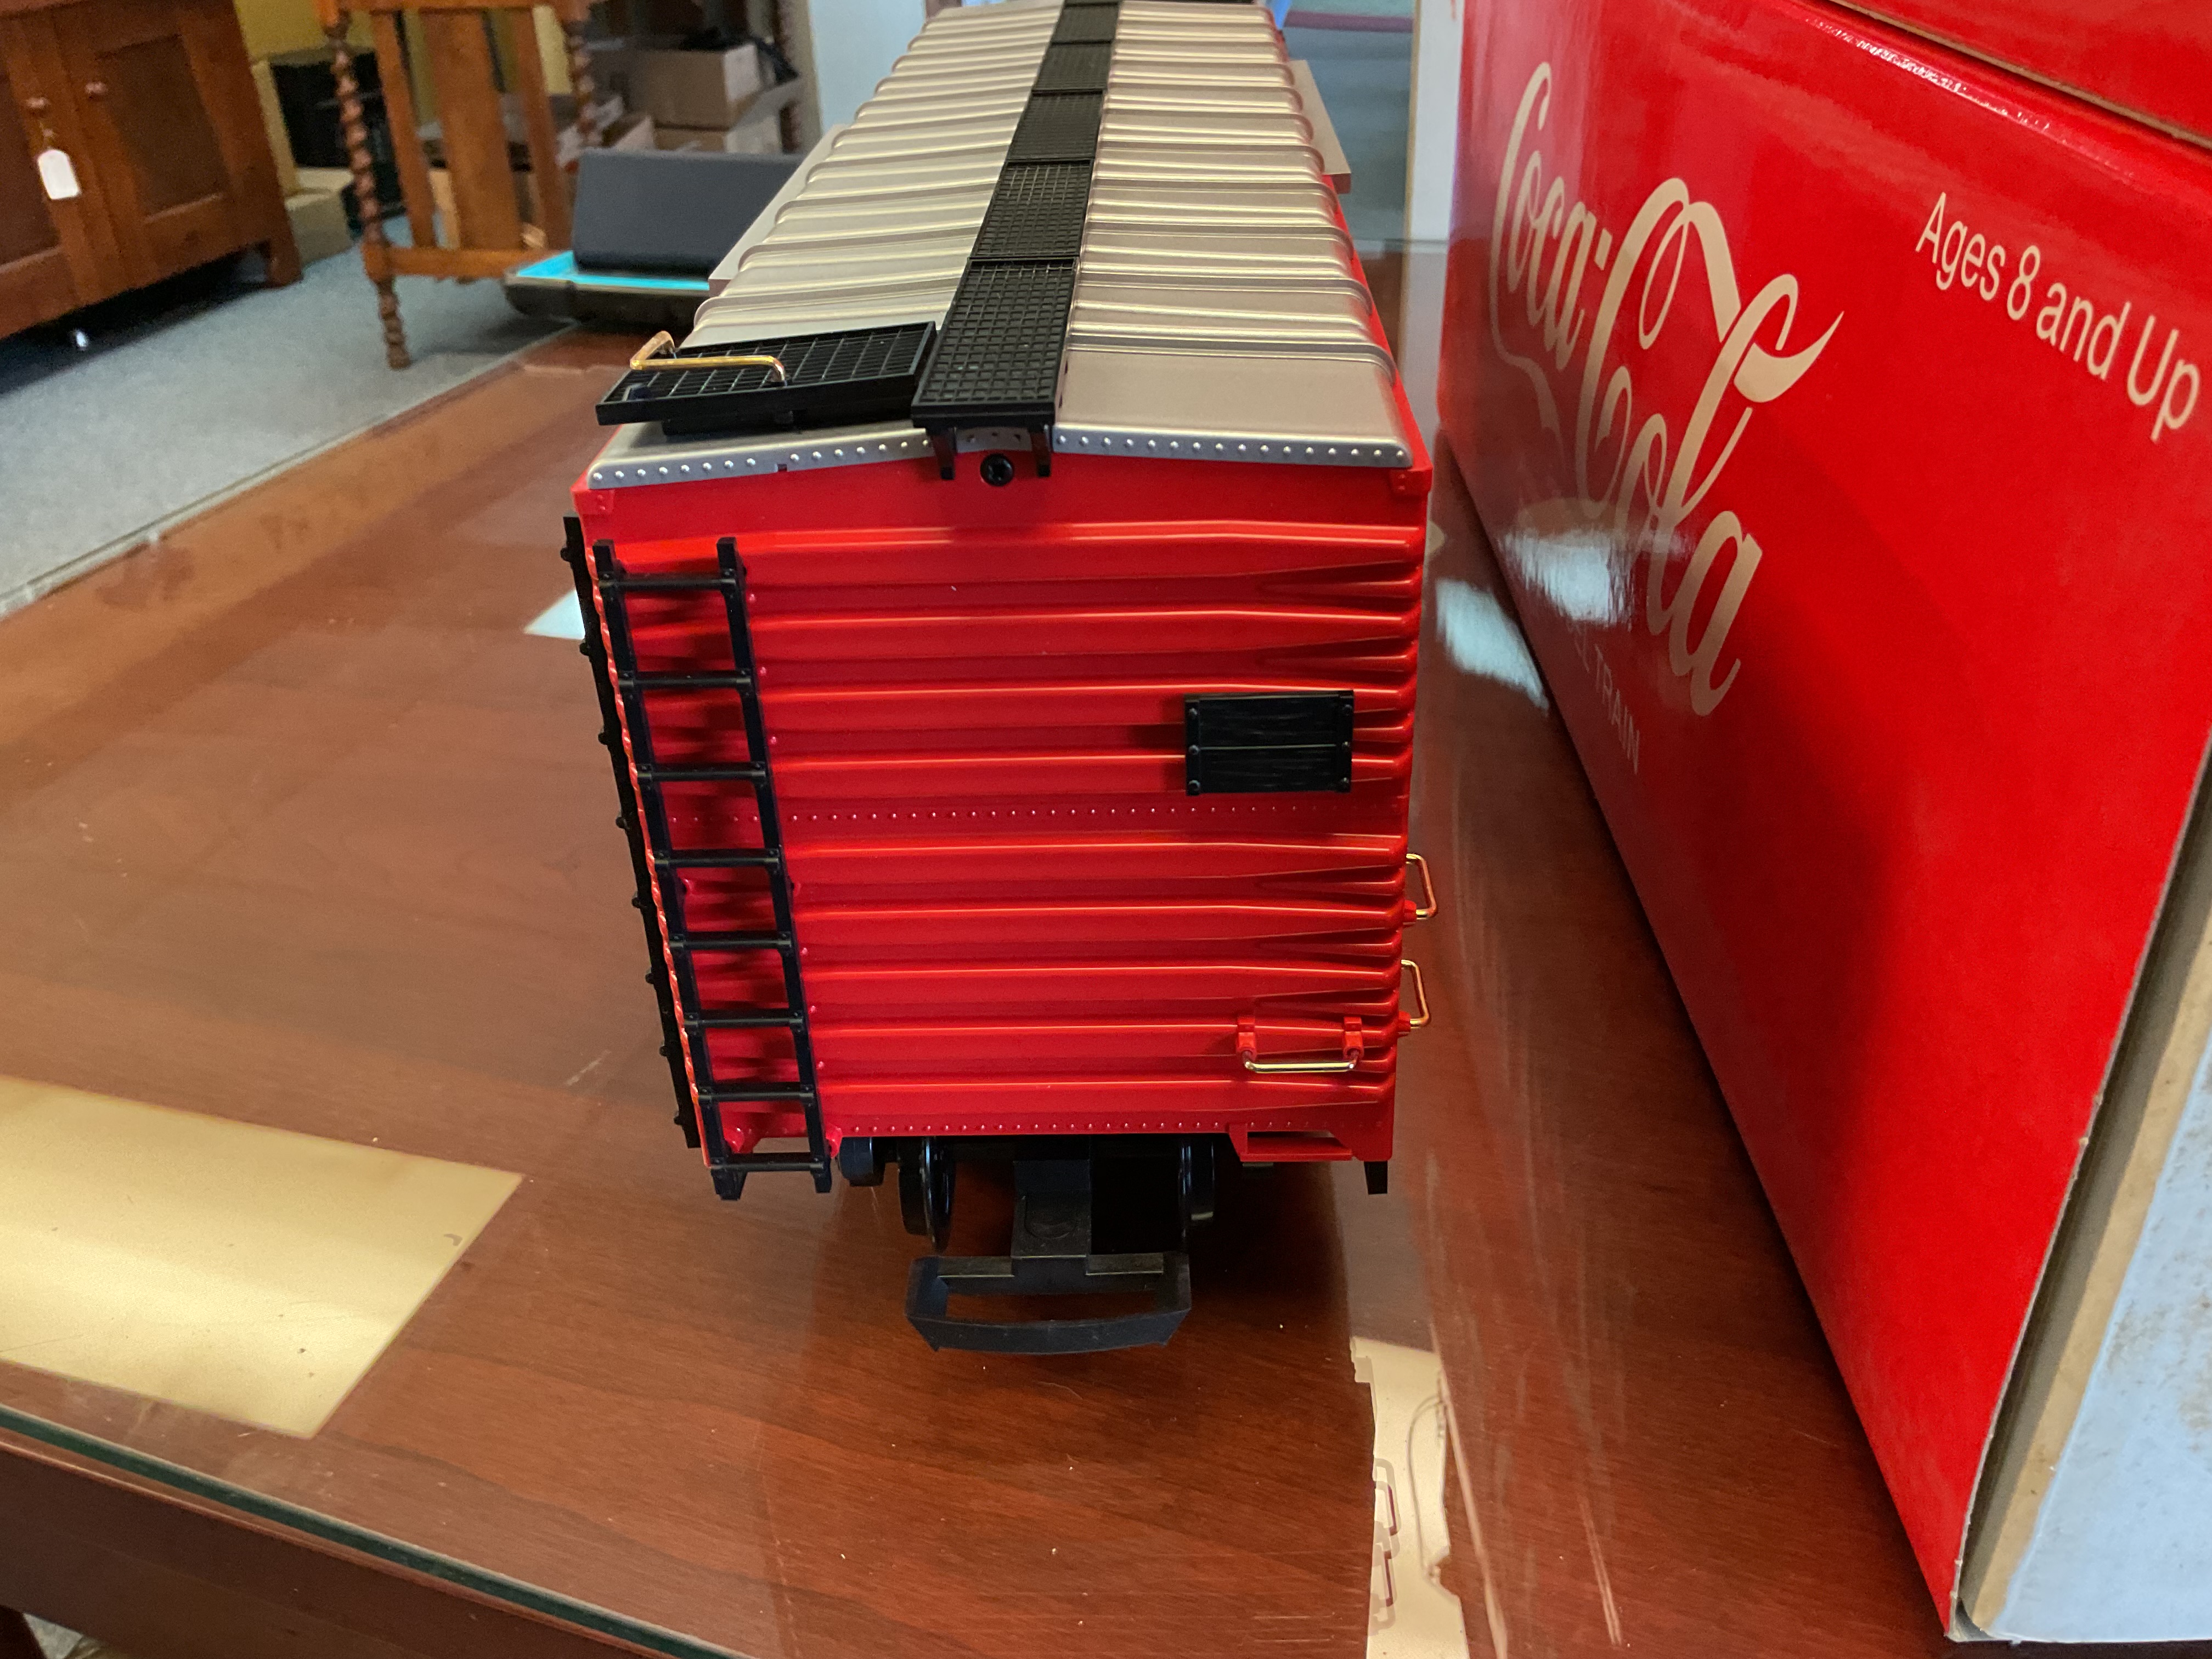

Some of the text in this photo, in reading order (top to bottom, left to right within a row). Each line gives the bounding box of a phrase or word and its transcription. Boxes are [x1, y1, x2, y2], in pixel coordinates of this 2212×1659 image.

[1914, 191, 2200, 442] Ages 8 and Up
[1594, 643, 1640, 776] TRAIN
